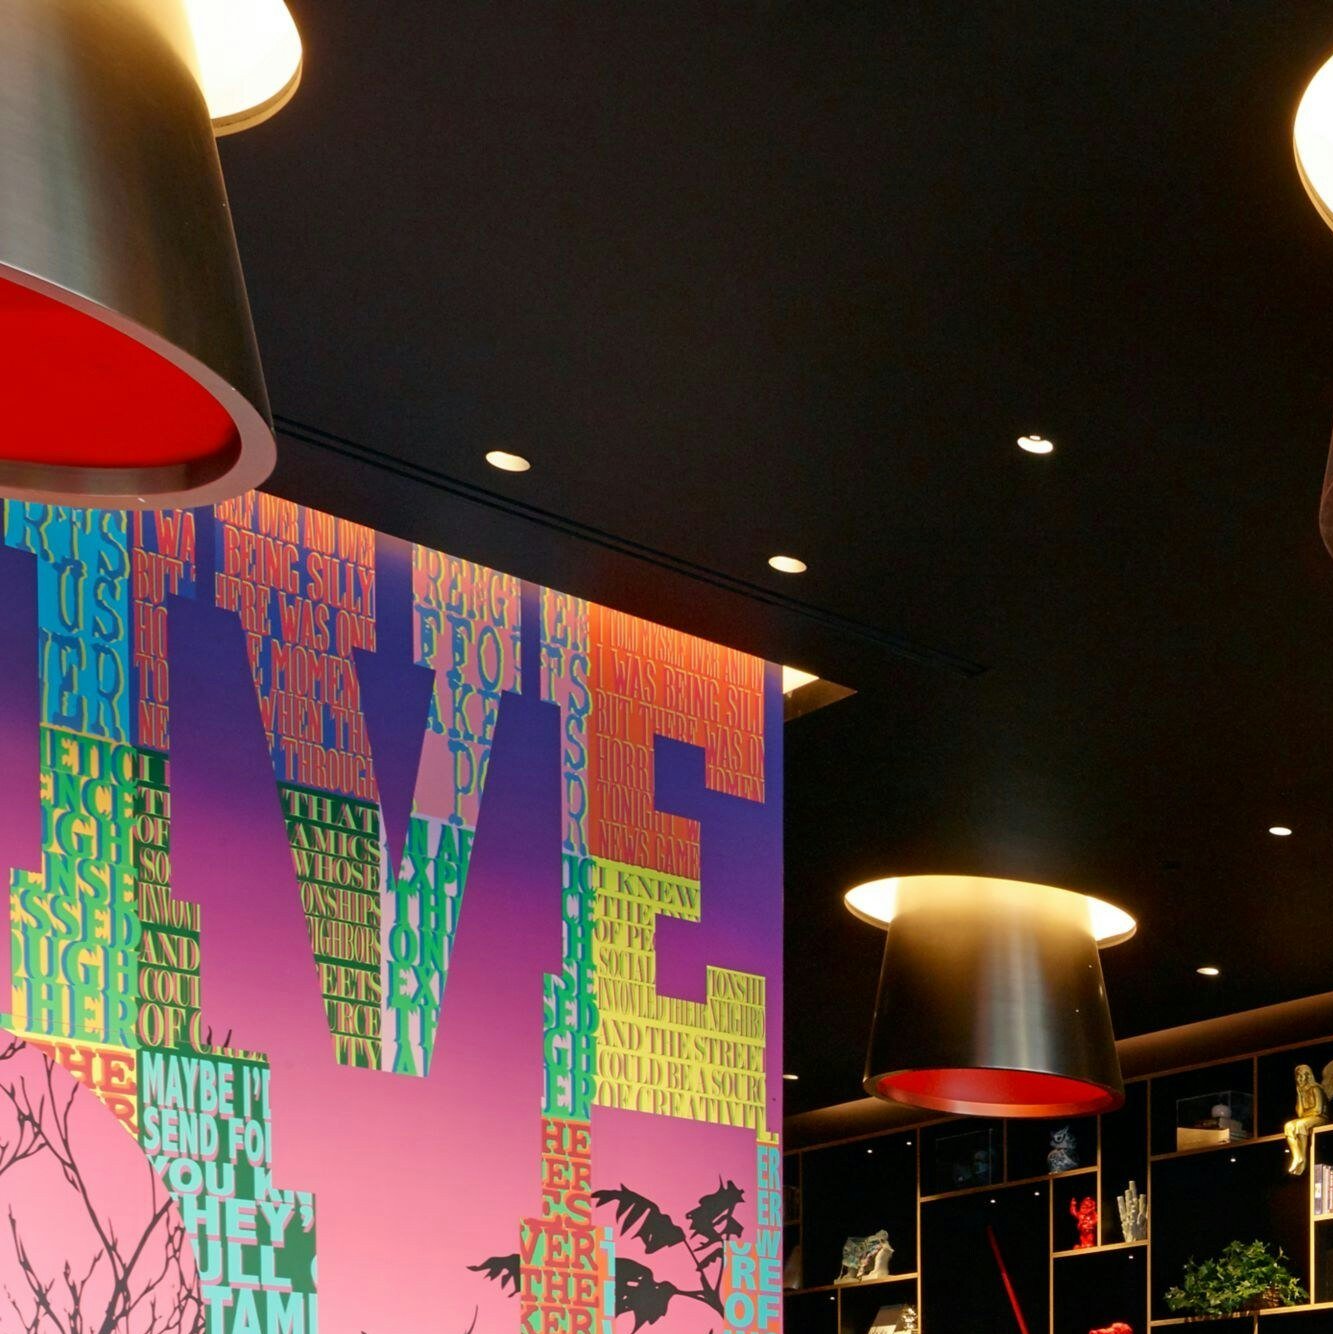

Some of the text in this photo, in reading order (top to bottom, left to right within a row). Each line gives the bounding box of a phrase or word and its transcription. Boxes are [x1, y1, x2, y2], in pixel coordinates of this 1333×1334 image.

[223, 523, 375, 619] BEING SILLY
[278, 589, 331, 653] WAS
[611, 649, 657, 705] WAS
[664, 665, 720, 722] BEING
[703, 719, 744, 774] WAS
[282, 788, 381, 836] THAT
[616, 870, 700, 912] KNEW
[597, 1018, 689, 1061] AND THE
[142, 1051, 235, 1120] MAYBE
[597, 1048, 663, 1088] COULD
[142, 1106, 219, 1160] SEND
